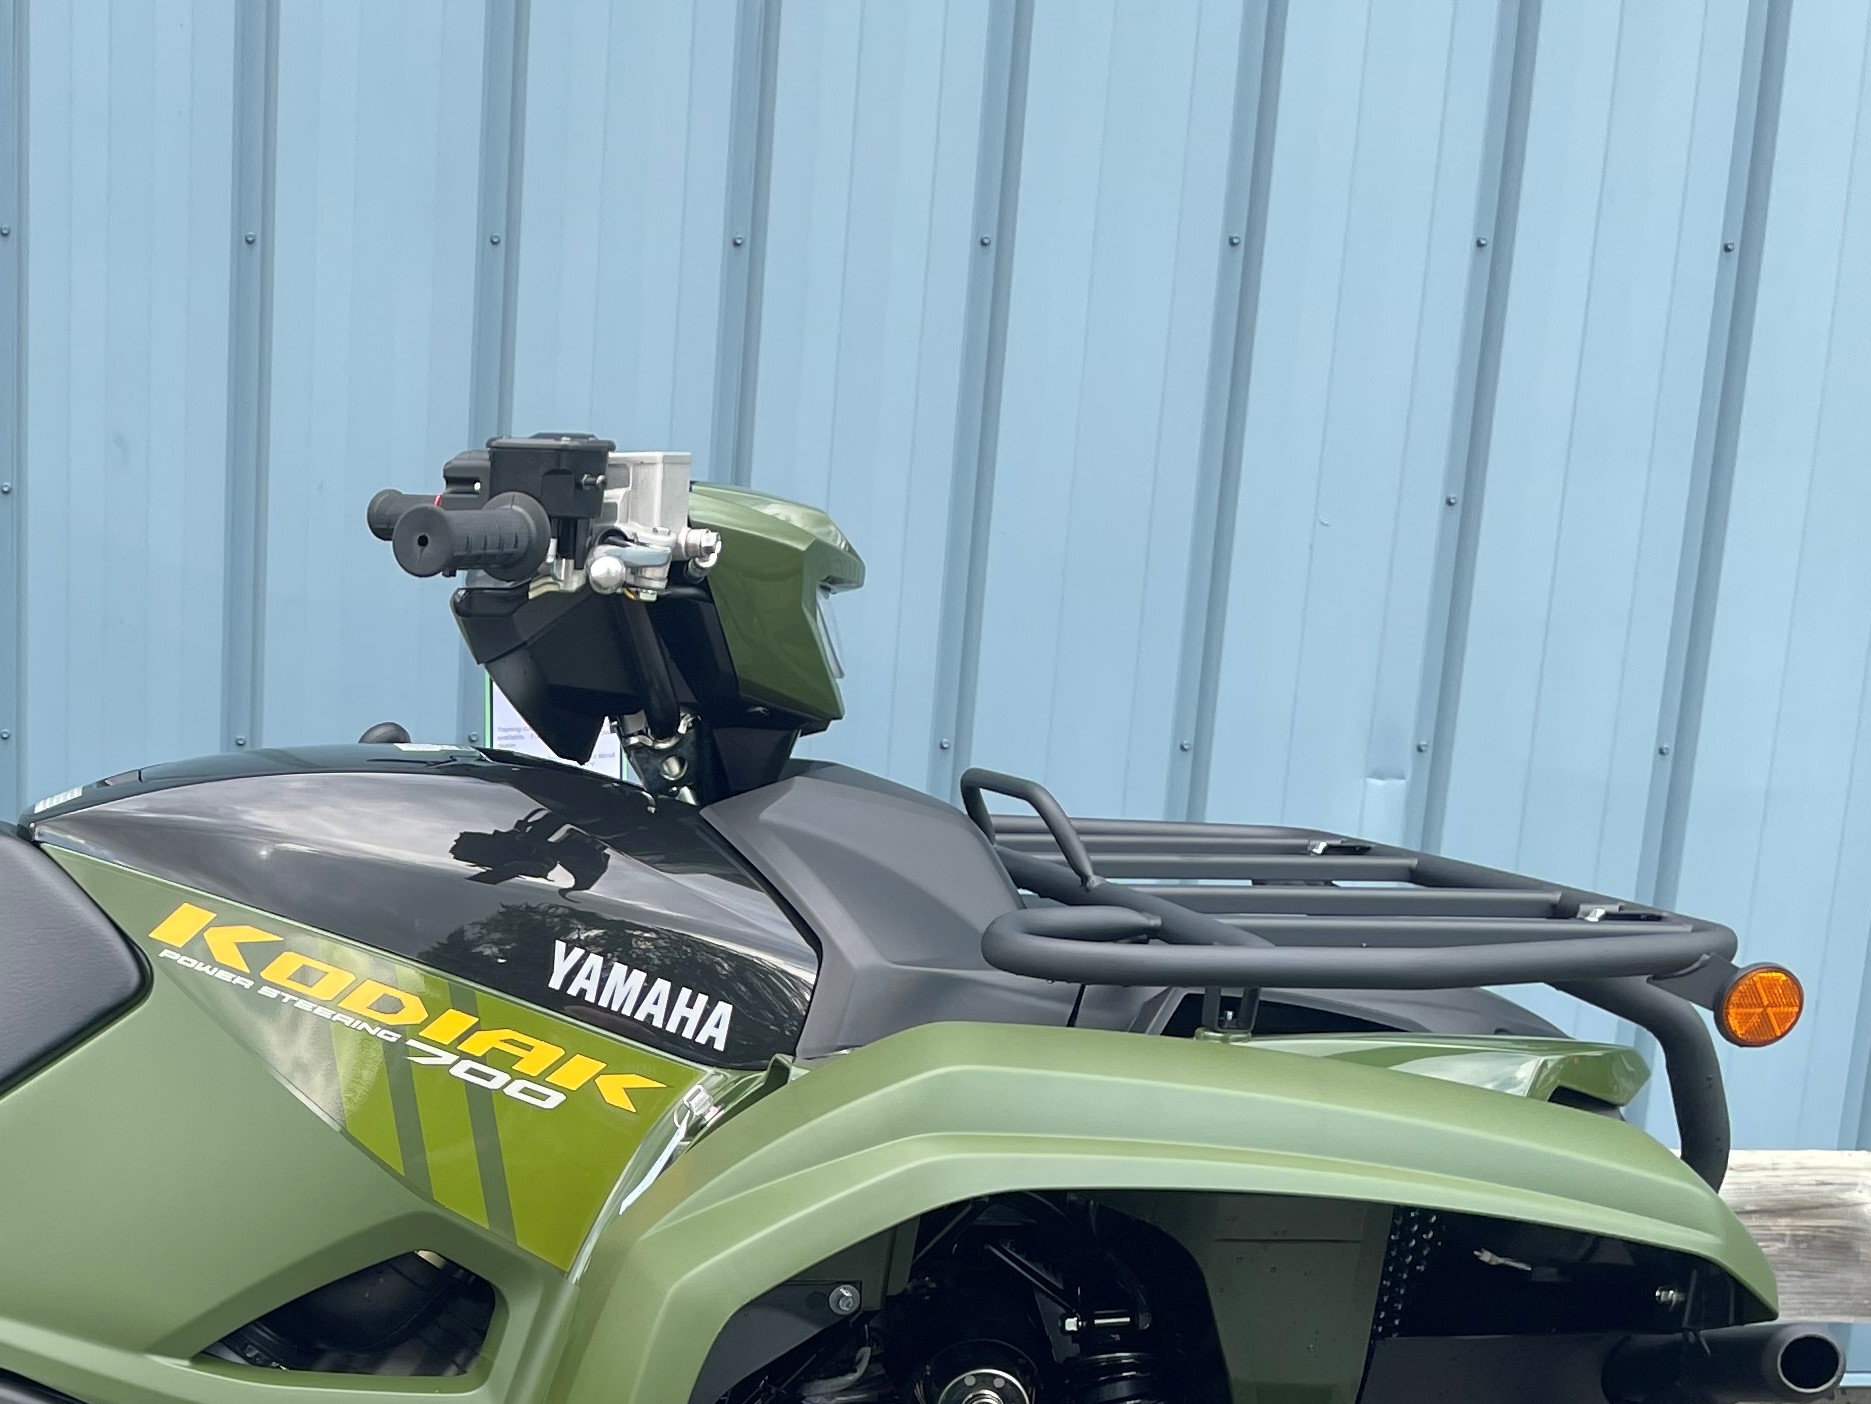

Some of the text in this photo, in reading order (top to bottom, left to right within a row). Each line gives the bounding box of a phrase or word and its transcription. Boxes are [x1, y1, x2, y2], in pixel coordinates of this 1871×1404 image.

[148, 902, 668, 1113] KODIAK
[158, 948, 402, 1043] POWER STEERING
[547, 939, 734, 1052] YAMAHA
[405, 1040, 566, 1110] 700
